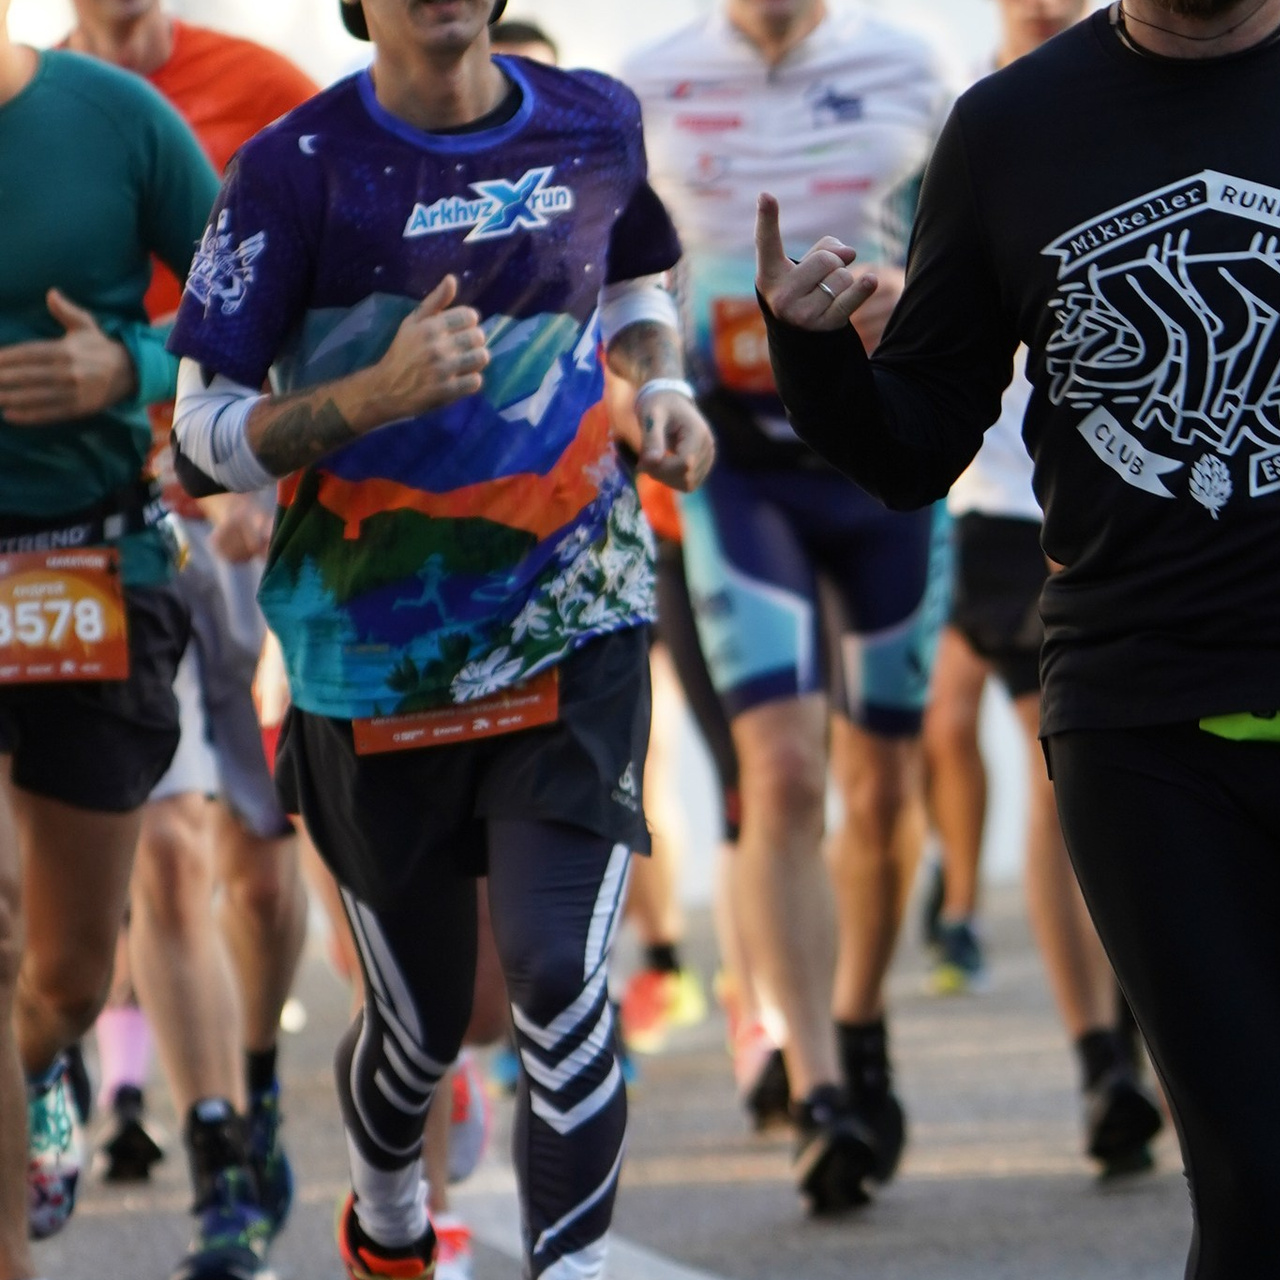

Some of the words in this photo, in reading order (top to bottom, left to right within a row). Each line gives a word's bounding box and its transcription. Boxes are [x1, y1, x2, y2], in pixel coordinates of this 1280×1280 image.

[409, 197, 494, 231] Arkhyz
[530, 188, 568, 210] run
[1070, 184, 1202, 257] Mikkeller
[1094, 423, 1144, 476] CLUB
